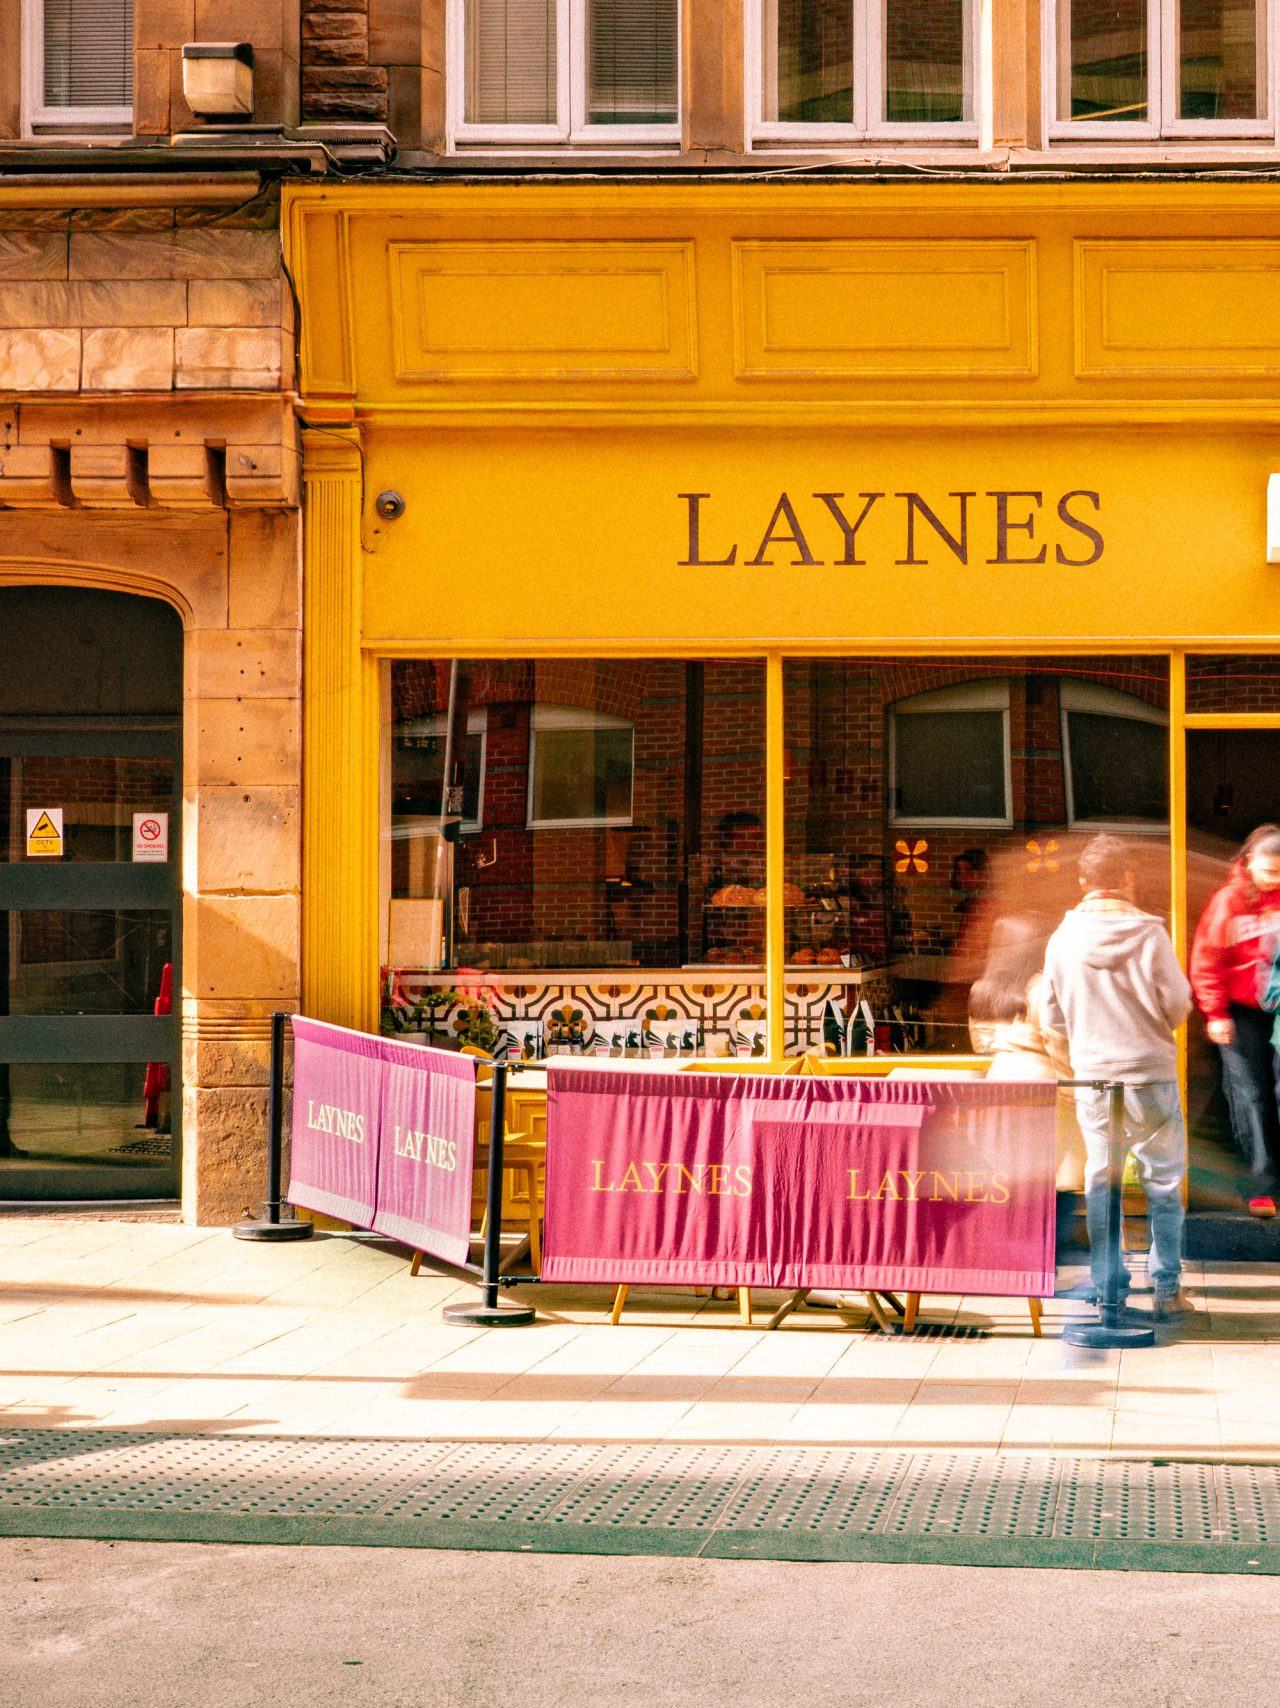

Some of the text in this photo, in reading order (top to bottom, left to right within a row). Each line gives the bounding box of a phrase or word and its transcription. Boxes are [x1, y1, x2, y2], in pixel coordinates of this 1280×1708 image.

[677, 491, 1105, 567] LAYNES
[307, 1100, 364, 1143] LAYNES
[395, 1126, 457, 1171] LAYNES
[591, 1160, 1011, 1205] LAYNES LAYNES
